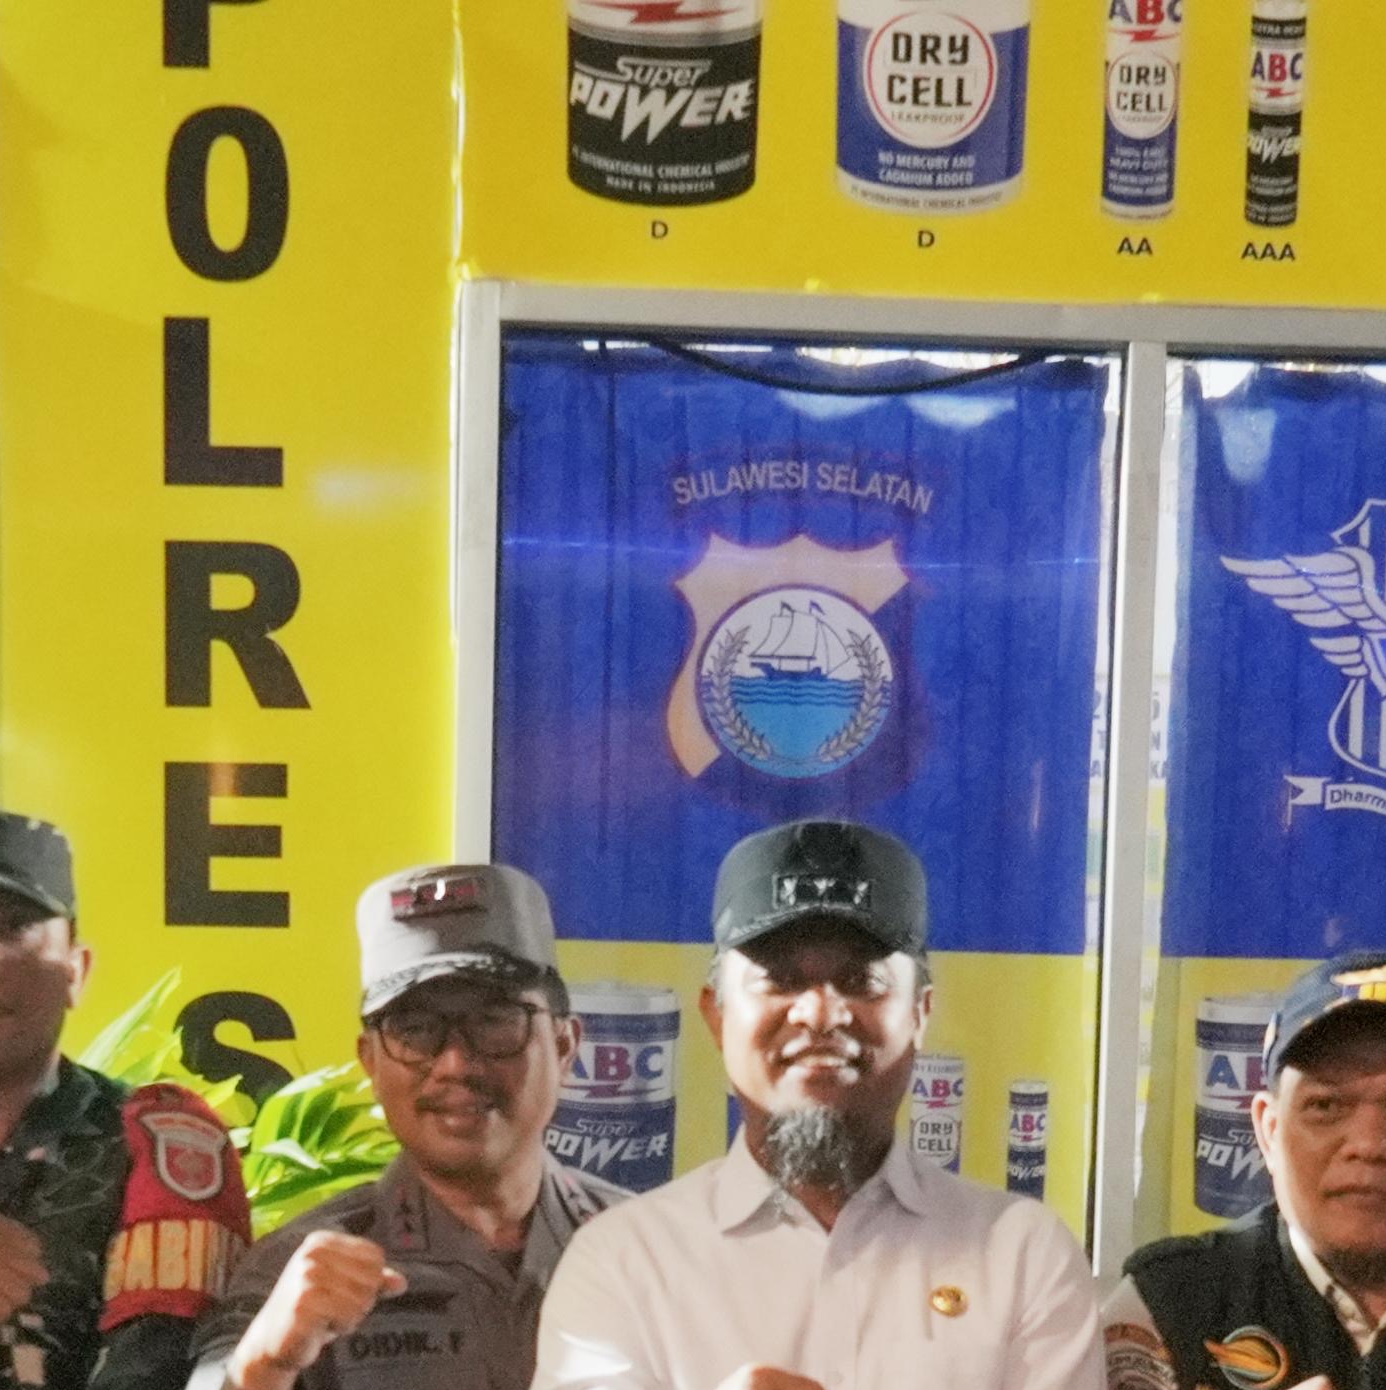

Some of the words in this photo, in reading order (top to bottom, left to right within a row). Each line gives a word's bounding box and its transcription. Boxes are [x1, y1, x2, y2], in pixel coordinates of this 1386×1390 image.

[892, 31, 969, 66] DRY
[616, 57, 713, 88] Super
[1119, 65, 1166, 86] DRY
[1251, 51, 1303, 82] ABC
[887, 75, 972, 108] CELL
[570, 71, 755, 145] POWER
[1116, 92, 1168, 113] CELL
[651, 221, 669, 239] D
[918, 232, 935, 248] D
[1117, 237, 1153, 255] AA
[1241, 242, 1296, 260] AAA
[672, 459, 809, 504] SULAWESI
[817, 462, 934, 515] SELATAN
[912, 1078, 964, 1099] ABC
[919, 1121, 953, 1135] DRY
[1010, 1113, 1046, 1133] ABC
[544, 1129, 669, 1171] POWER
[917, 1138, 952, 1151] CELL
